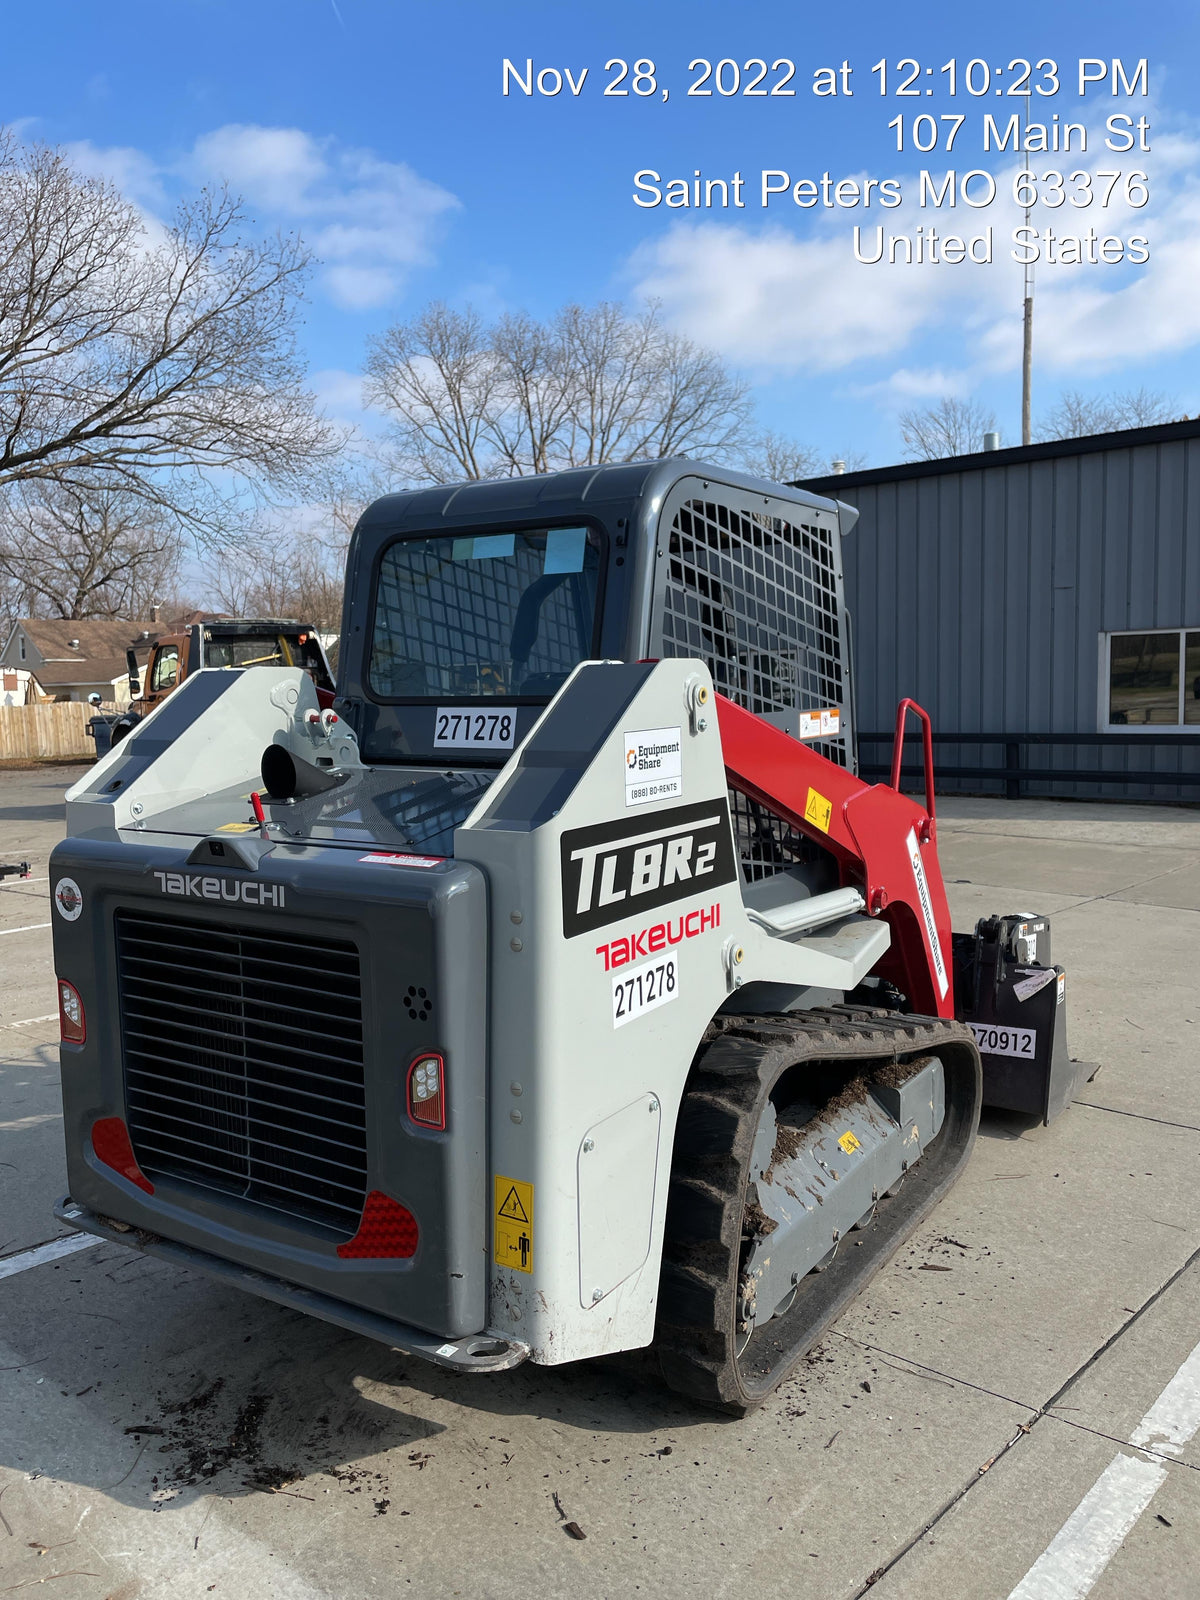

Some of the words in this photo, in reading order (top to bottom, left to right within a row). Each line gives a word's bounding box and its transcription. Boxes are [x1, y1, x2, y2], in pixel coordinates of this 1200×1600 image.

[437, 715, 512, 741] 271278
[638, 742, 680, 758] Equipment
[638, 758, 661, 770] Share
[570, 815, 721, 915] TL8R2
[615, 961, 675, 1019] 271278
